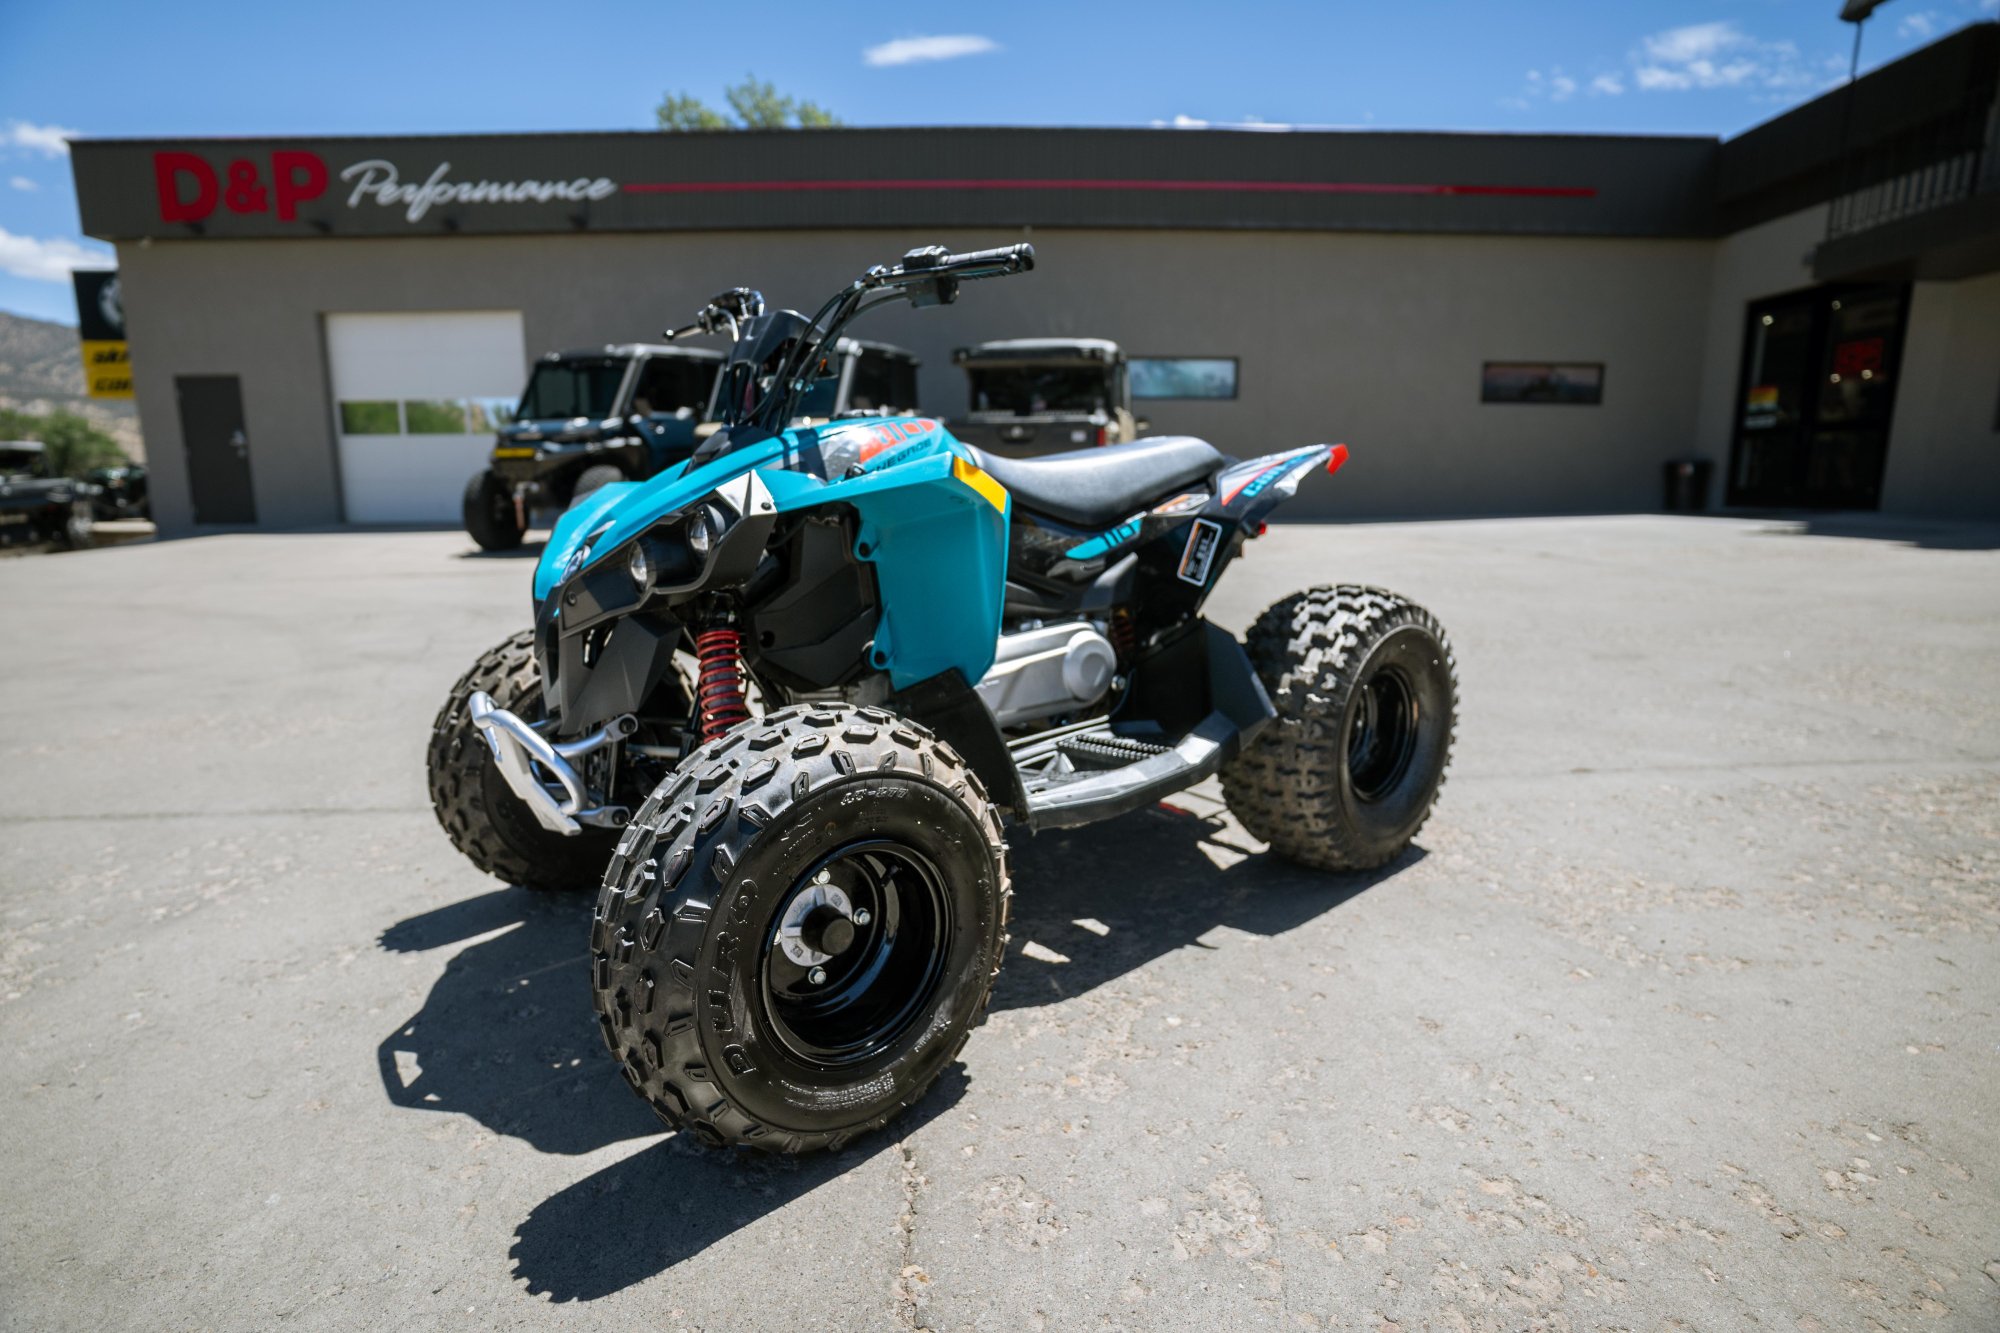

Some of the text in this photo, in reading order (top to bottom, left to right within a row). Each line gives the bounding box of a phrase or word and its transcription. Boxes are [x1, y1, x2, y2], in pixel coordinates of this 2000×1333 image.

[152, 150, 617, 223] D&P Performance
[708, 879, 759, 1079] DURO
